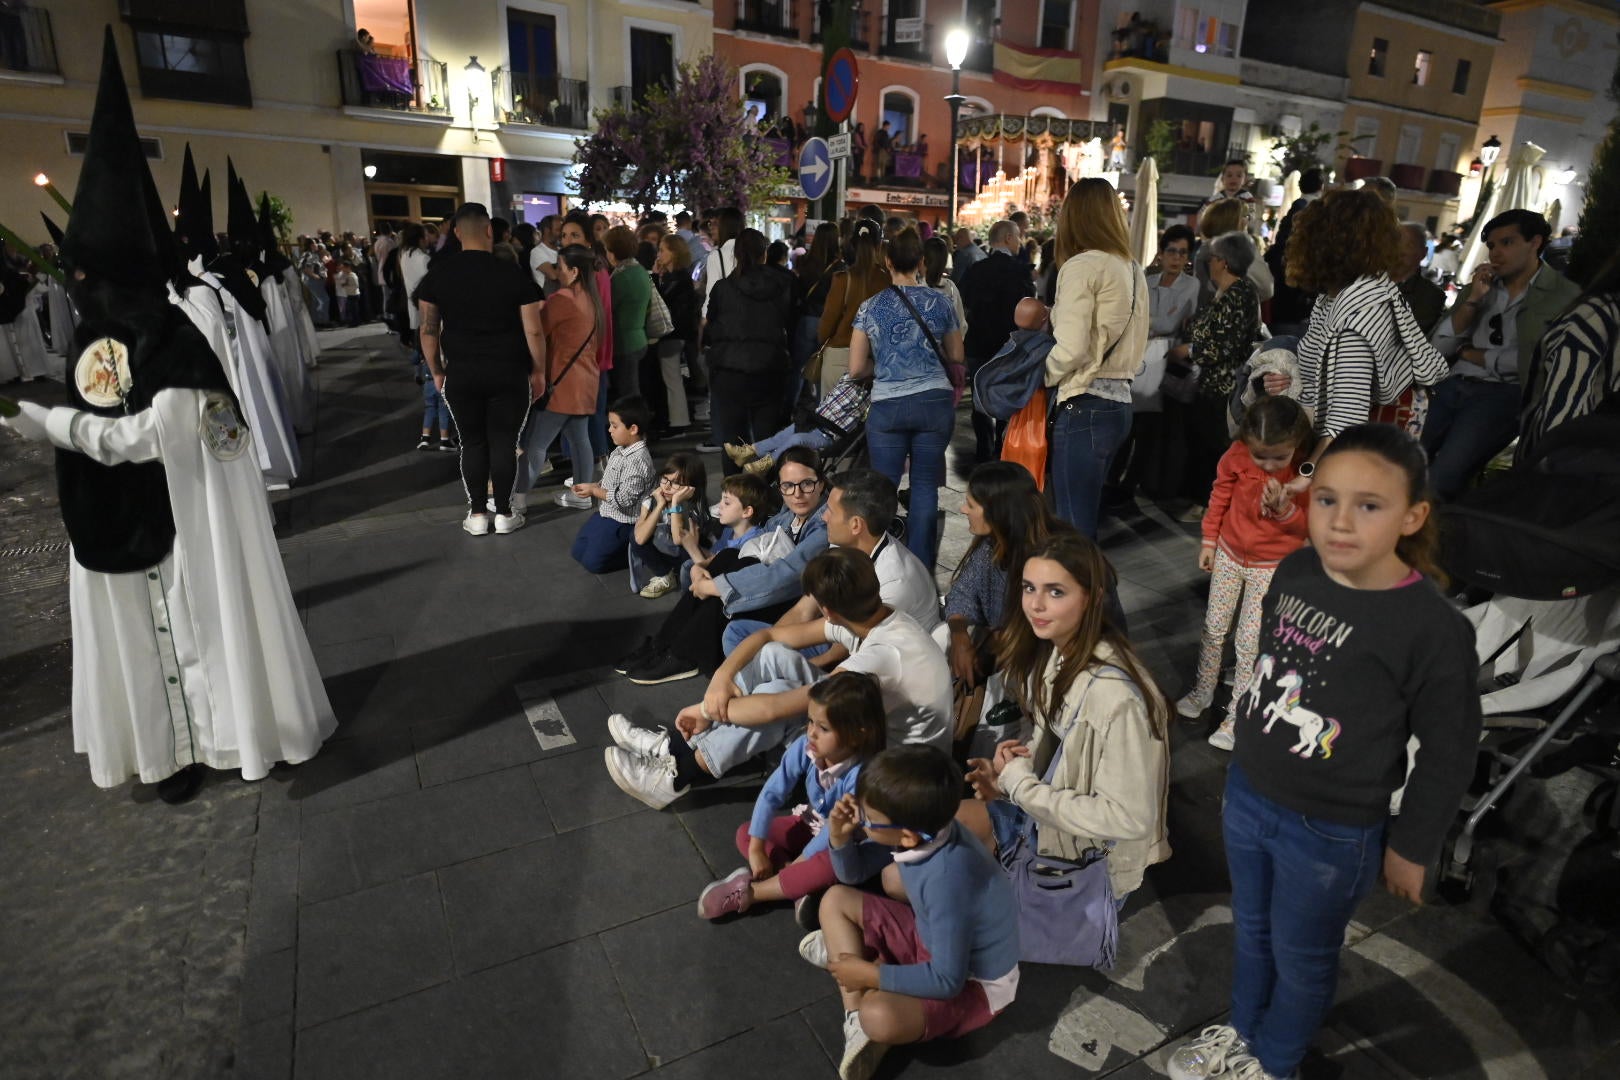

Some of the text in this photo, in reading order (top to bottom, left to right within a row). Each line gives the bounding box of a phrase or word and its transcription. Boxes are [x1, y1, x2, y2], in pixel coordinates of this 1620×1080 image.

[886, 192, 923, 204] Embdos
[1273, 611, 1326, 654] Squad
[1274, 593, 1354, 648] UNICORN
